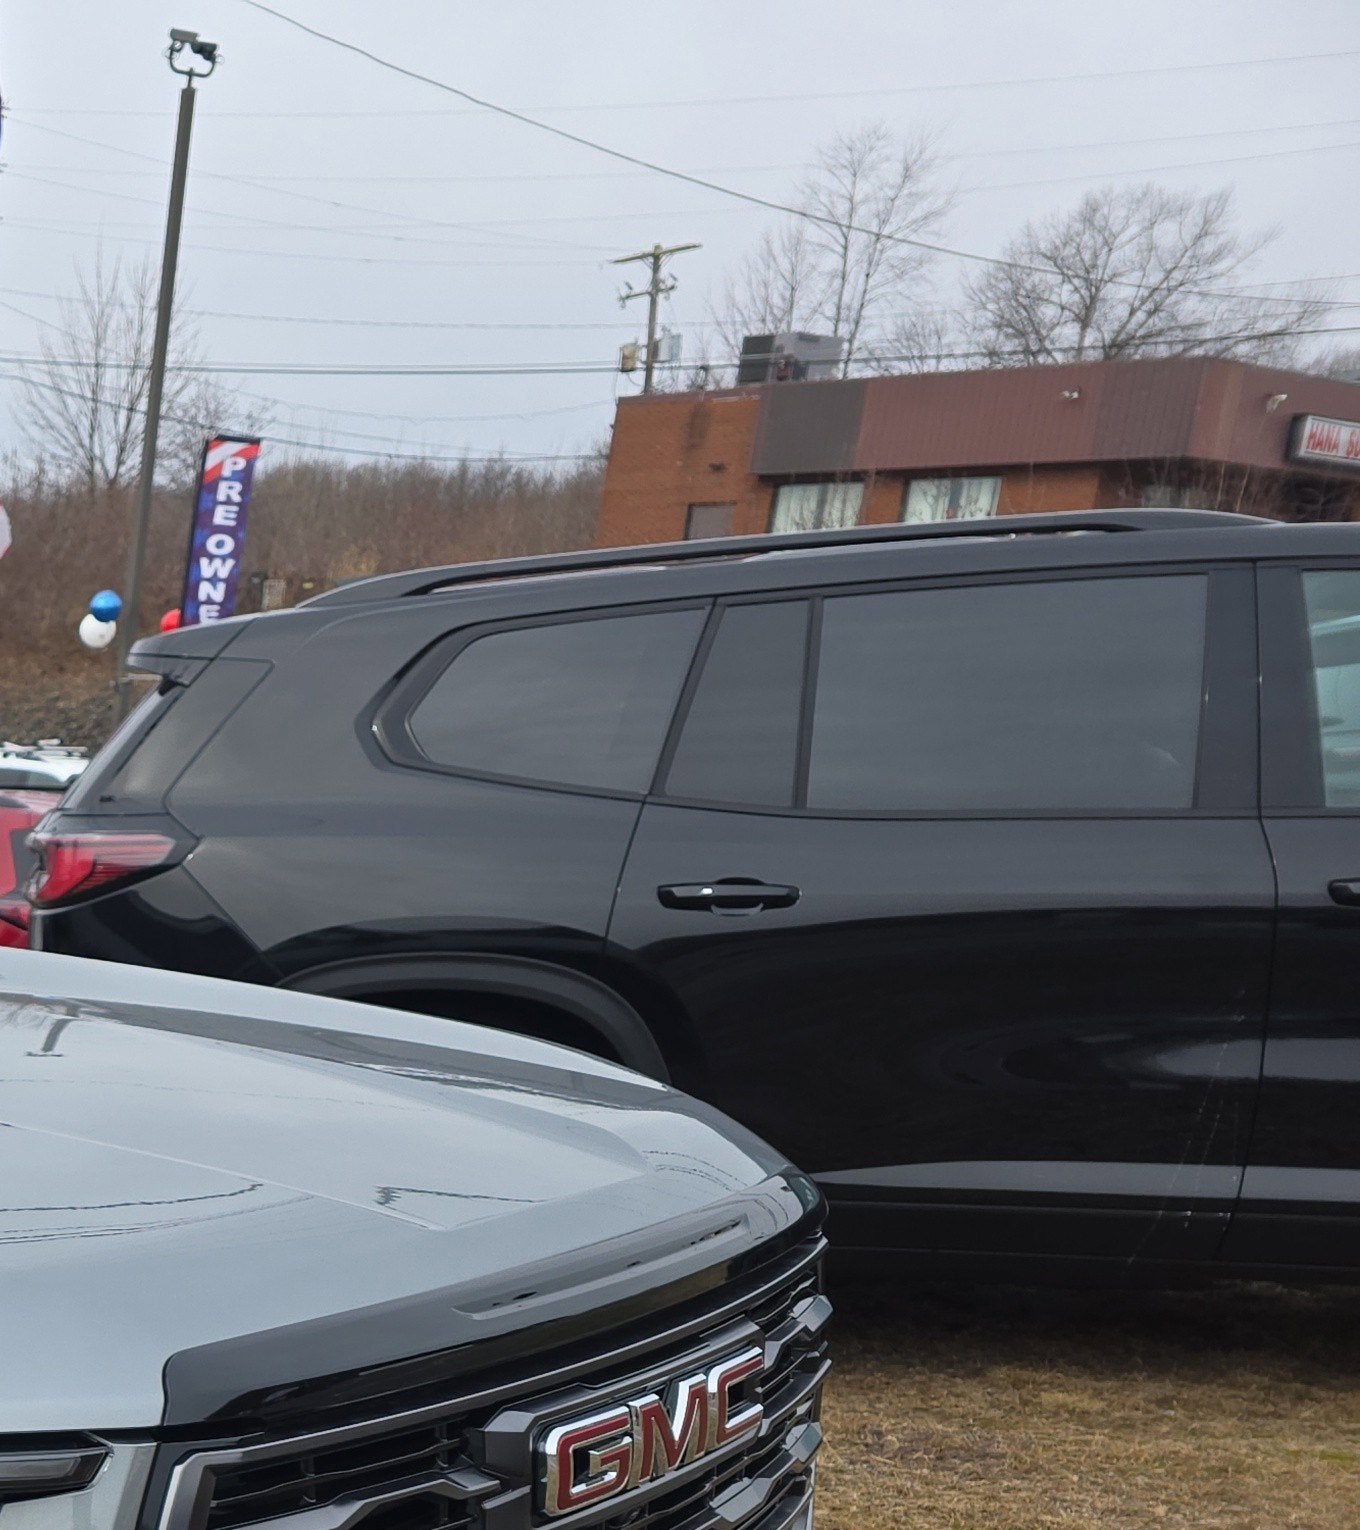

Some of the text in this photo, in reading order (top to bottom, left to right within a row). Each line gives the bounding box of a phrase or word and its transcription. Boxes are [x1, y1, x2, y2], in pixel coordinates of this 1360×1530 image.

[1306, 422, 1341, 452] HANA
[212, 455, 247, 527] PRE
[545, 1347, 764, 1517] GMC
